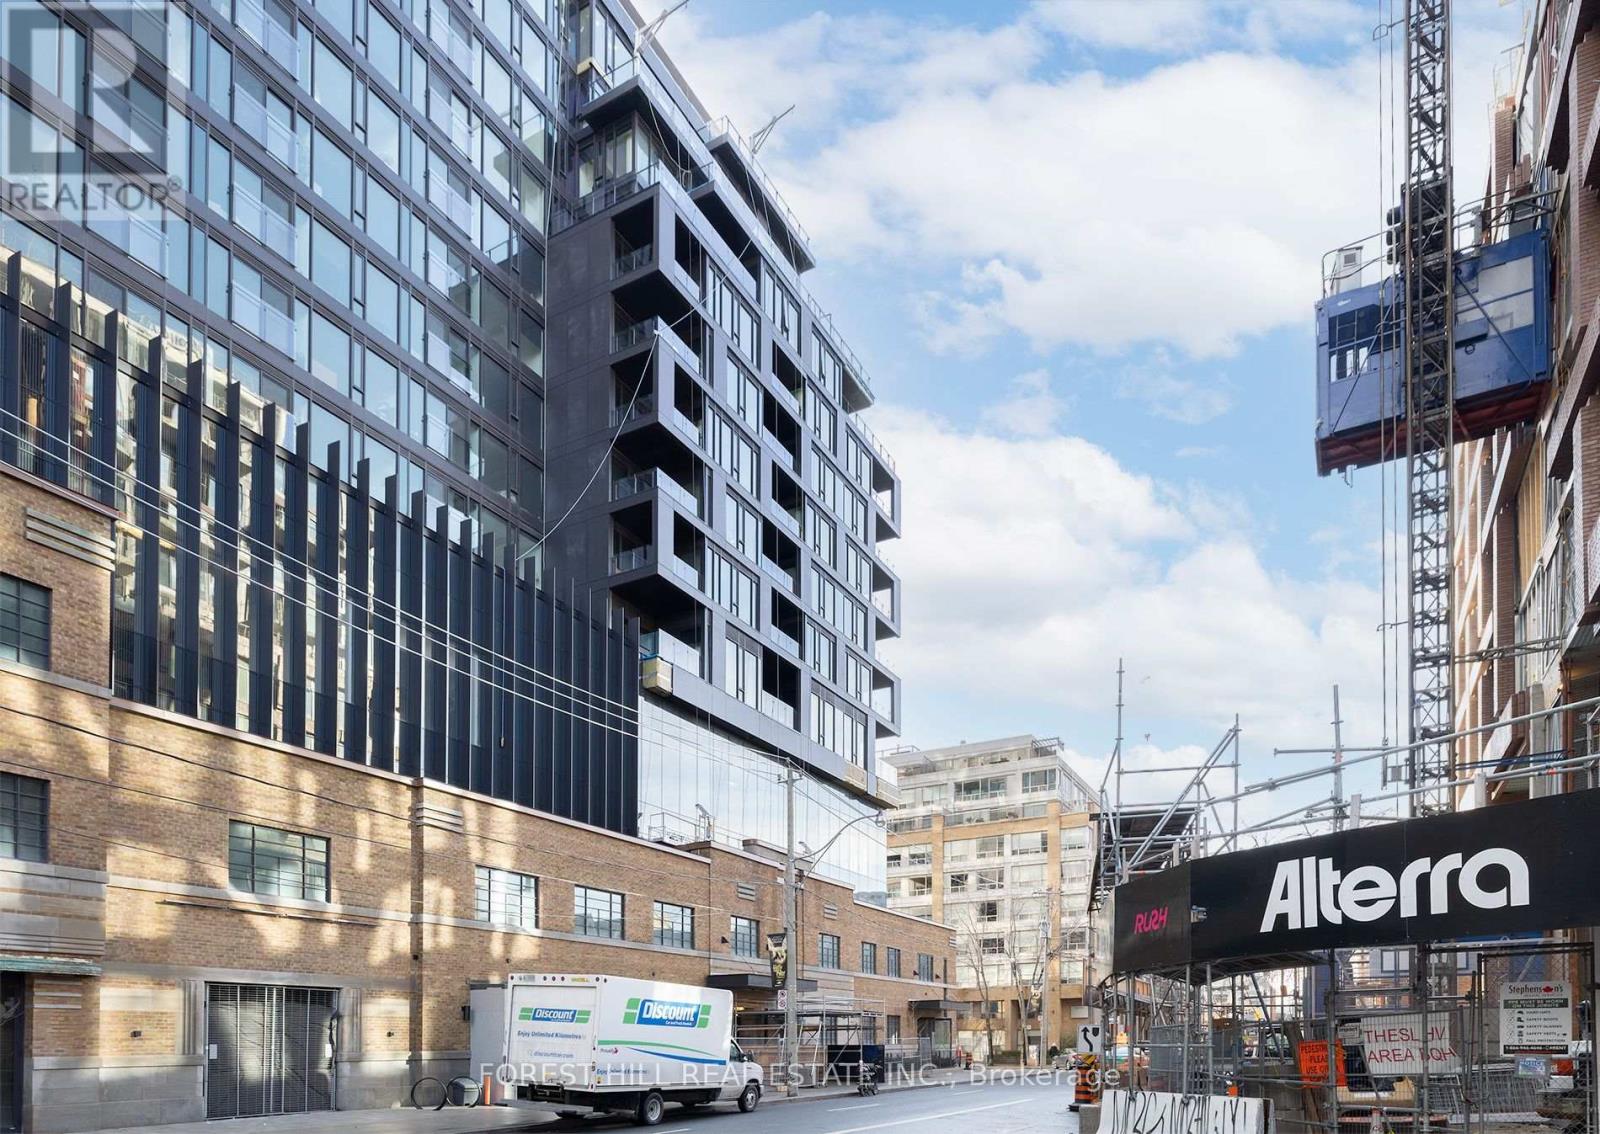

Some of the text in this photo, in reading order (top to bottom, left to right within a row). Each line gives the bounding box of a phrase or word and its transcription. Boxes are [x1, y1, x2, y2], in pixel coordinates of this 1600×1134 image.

[1260, 848, 1530, 933] Alterra
[1508, 984, 1564, 995] Stephensn's
[535, 1009, 574, 1020] Discount
[642, 1001, 697, 1022] Discount
[1364, 1028, 1419, 1044] THESL
[1367, 1048, 1415, 1063] AREA
